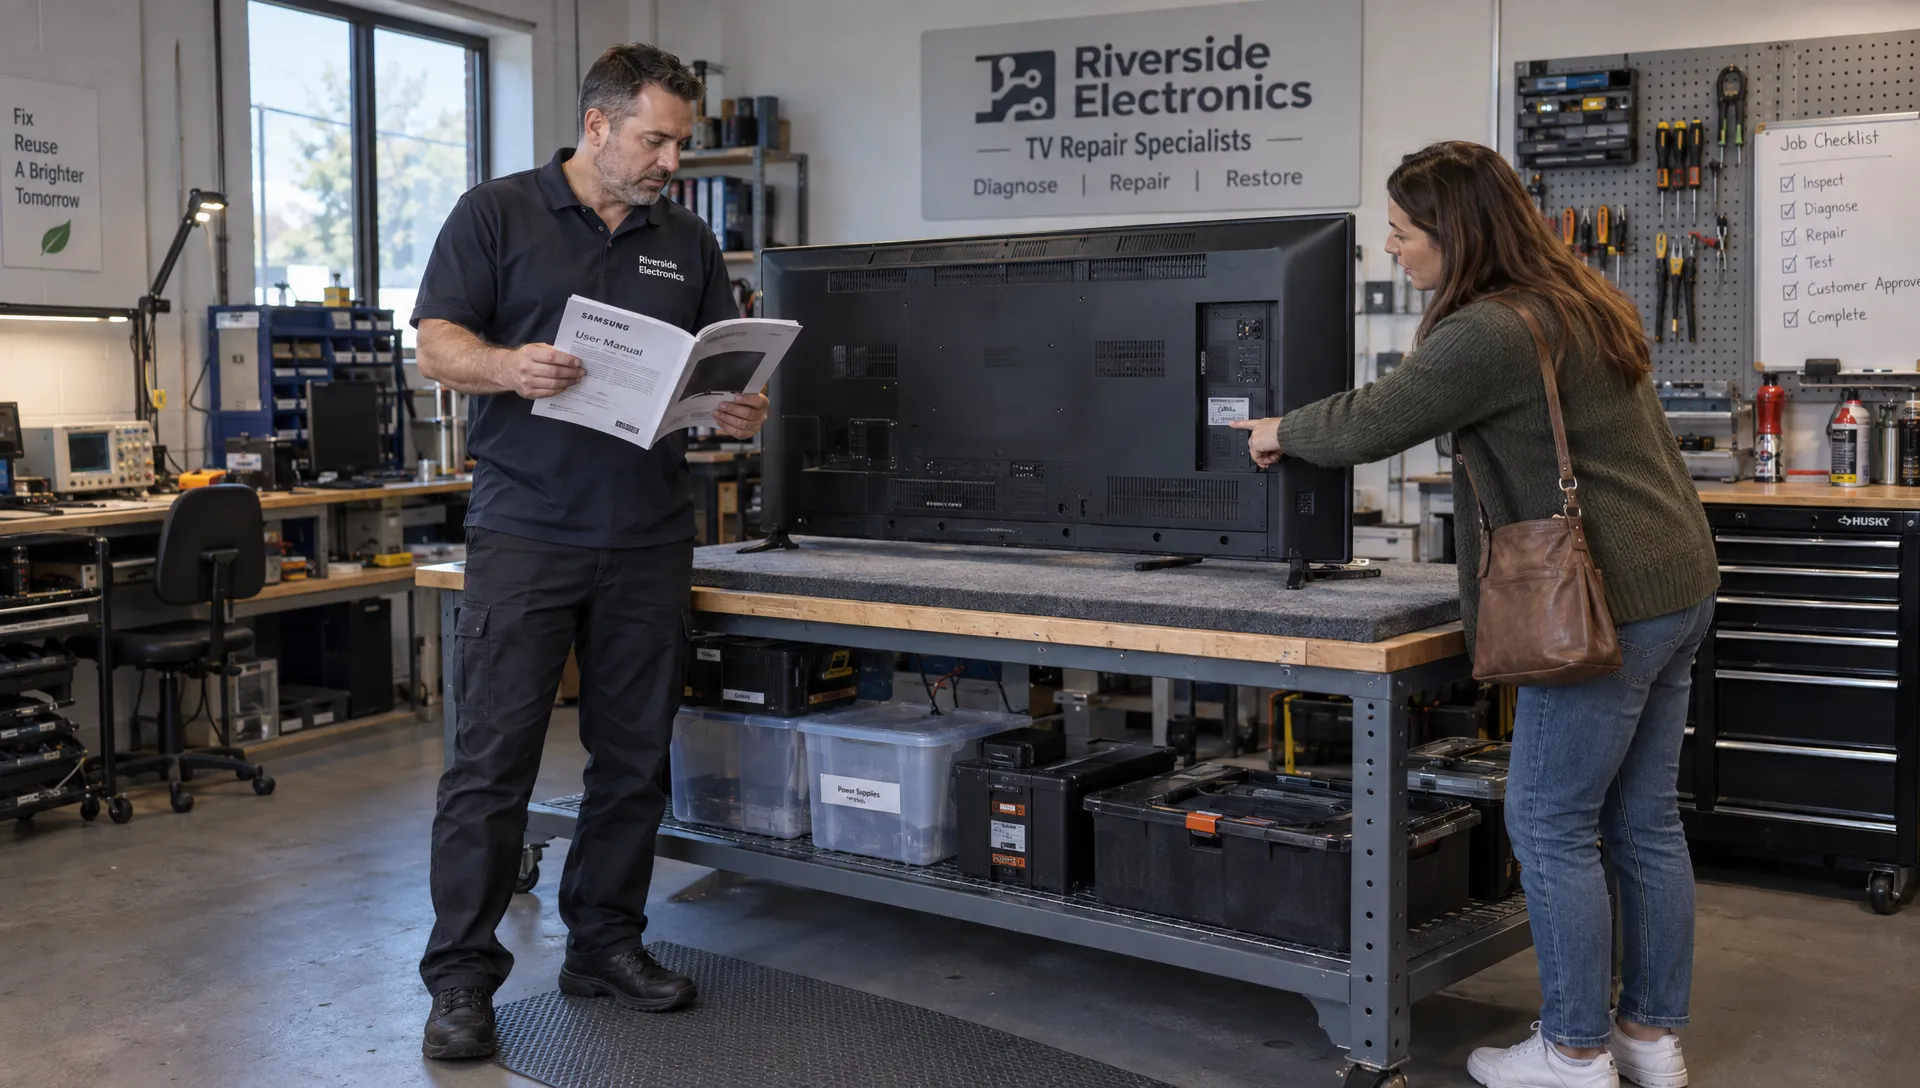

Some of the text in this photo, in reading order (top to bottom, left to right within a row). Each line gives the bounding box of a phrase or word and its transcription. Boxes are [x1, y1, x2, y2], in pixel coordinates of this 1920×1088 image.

[1075, 34, 1270, 79] Riverside
[1074, 74, 1312, 118] Electronics
[13, 107, 34, 126] Fix
[14, 133, 58, 155] Reuse
[1026, 128, 1251, 162] TV Repair Specialists
[1780, 129, 1879, 151] Job Checklist
[14, 160, 84, 185] A Brighter
[973, 169, 1303, 199] Diagnose Repair Restore
[1803, 173, 1844, 192] Inspect
[15, 186, 80, 208] Tomorrow
[1804, 202, 1858, 219] Diagnose
[1805, 226, 1847, 245] Repair
[639, 255, 678, 270] Riverside
[1805, 254, 1834, 269] Test
[639, 265, 685, 282] Electronics
[1807, 281, 1868, 297] Customer
[581, 312, 630, 331] SAMSUNG
[1808, 308, 1868, 327] Complete
[575, 330, 644, 357] User Manual
[1852, 516, 1890, 526] HUSKY
